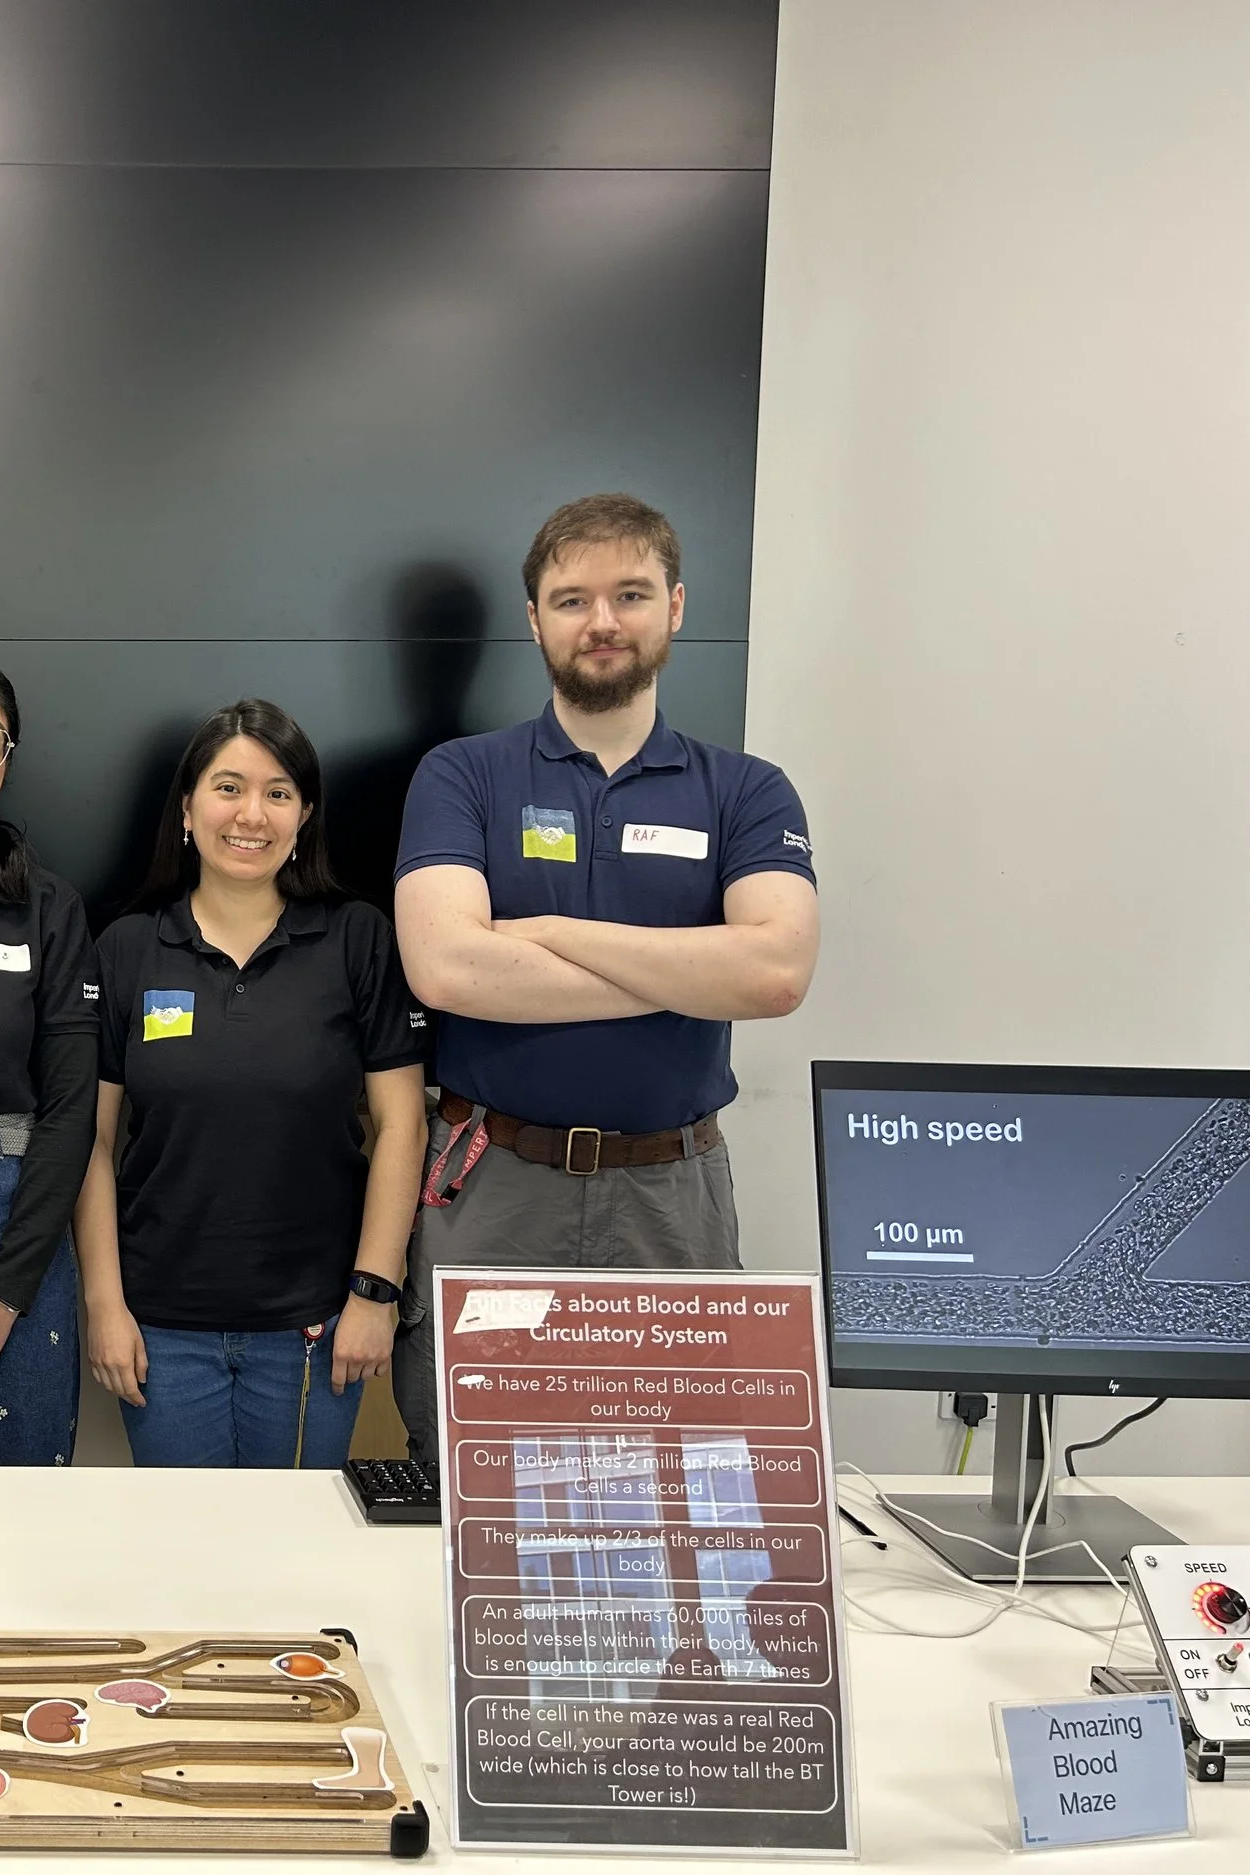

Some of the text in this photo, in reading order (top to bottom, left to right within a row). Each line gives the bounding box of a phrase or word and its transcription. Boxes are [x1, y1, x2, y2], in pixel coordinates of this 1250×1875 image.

[633, 829, 659, 841] RAF
[847, 1113, 1022, 1146] High speed
[874, 1223, 918, 1243] 100
[568, 1295, 631, 1314] about
[637, 1295, 699, 1315] Blood
[706, 1297, 747, 1315] and
[753, 1301, 790, 1316] our
[528, 1322, 727, 1348] Circulatory System
[499, 1374, 540, 1392] have
[545, 1376, 567, 1392] 25
[572, 1376, 629, 1393] trillion
[633, 1378, 668, 1394] Red
[673, 1379, 726, 1395] Blood
[731, 1379, 775, 1396] Cells
[780, 1381, 795, 1396] in
[591, 1401, 672, 1421] our body
[473, 1450, 801, 1472] Our body makes 2 million Red Blood
[574, 1478, 703, 1495] Cells a second
[481, 1528, 802, 1551] They make up 2/3 of the cells in our
[619, 1555, 665, 1575] body
[1184, 1563, 1227, 1574] SPEED
[482, 1604, 807, 1626] An adult human has 60,000 miles of
[475, 1628, 818, 1656] blood vessels within their body, which
[1180, 1649, 1201, 1660] ON
[485, 1656, 811, 1679] is enough to circle the Earth 7 times
[1184, 1668, 1209, 1680] OFF
[485, 1704, 813, 1728] If the cell in the maze was a real Red
[1048, 1713, 1142, 1741] Amazing
[477, 1730, 824, 1754] Blood Cell, your aorta would be 200m
[479, 1757, 824, 1780] wide (which is close to how tall the BT
[1053, 1750, 1118, 1778] Blood
[608, 1785, 696, 1806] Tower is!)
[1059, 1793, 1116, 1815] Maze
